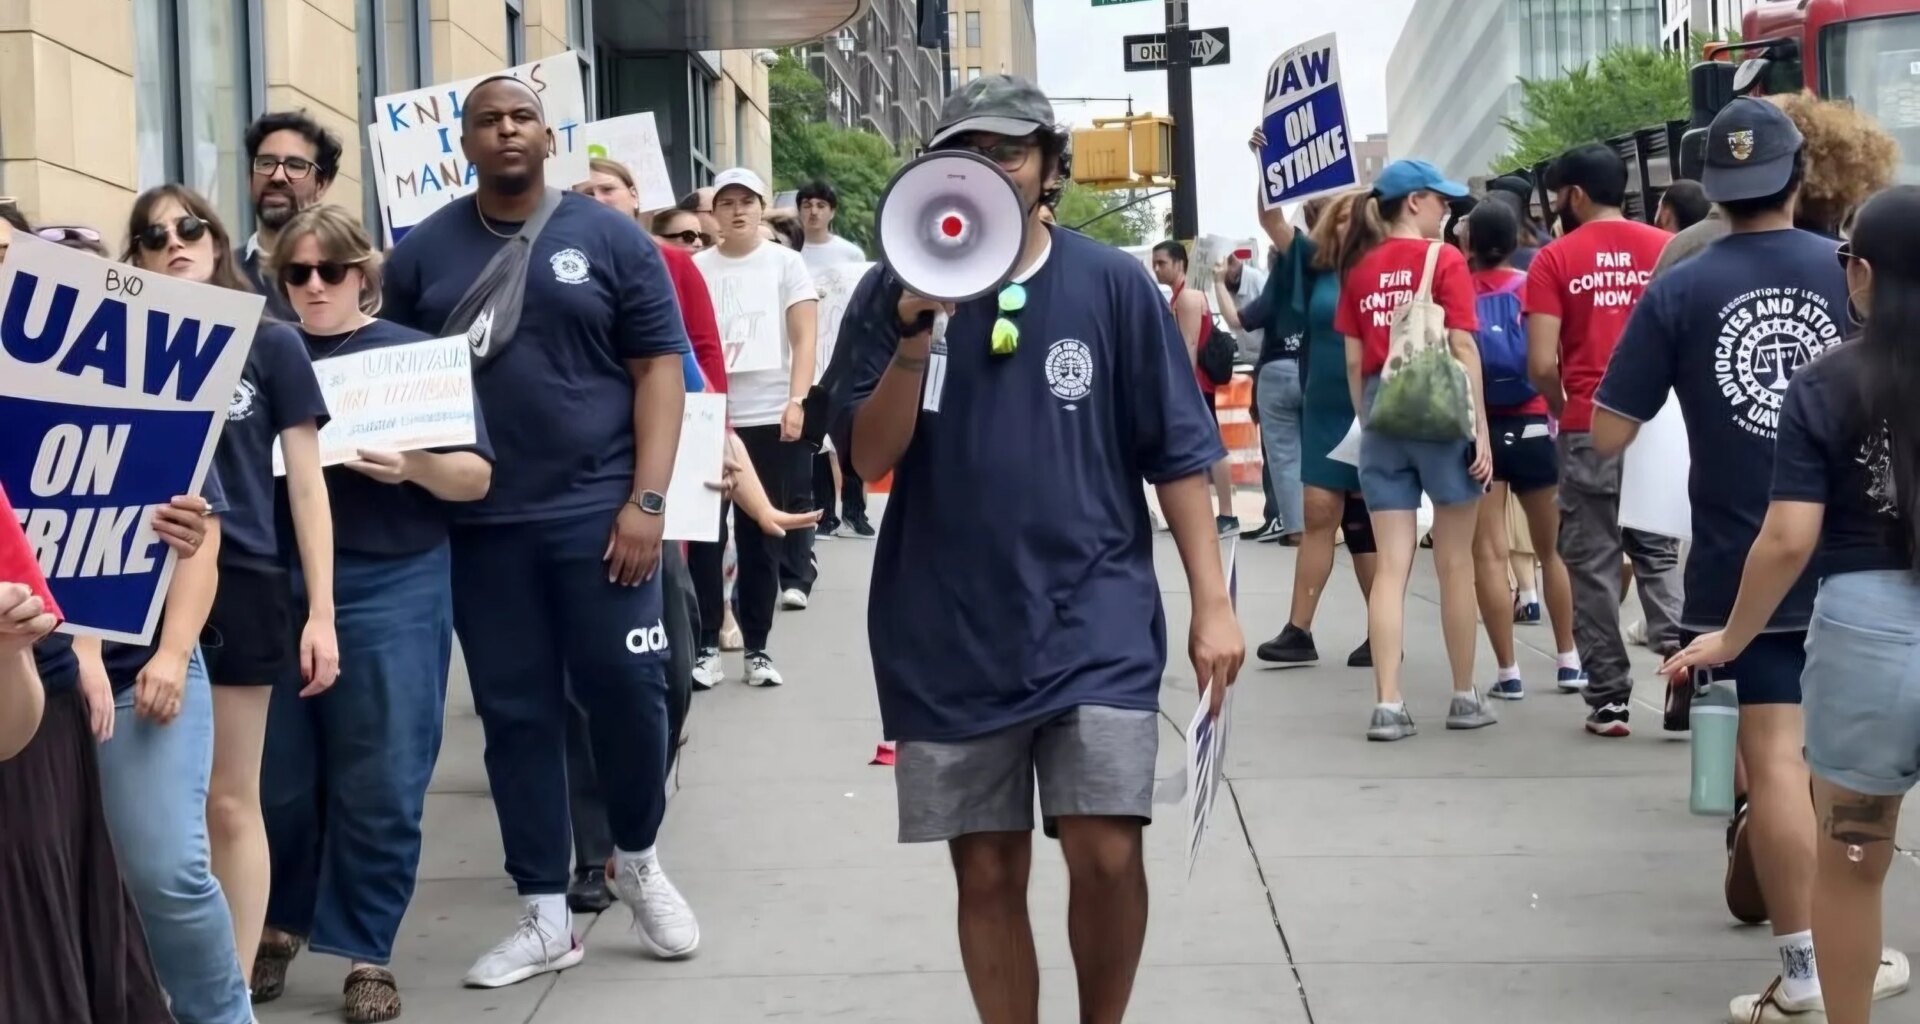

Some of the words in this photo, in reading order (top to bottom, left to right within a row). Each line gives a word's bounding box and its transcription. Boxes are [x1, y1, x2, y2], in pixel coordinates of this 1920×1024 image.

[1266, 48, 1331, 103] UAW
[1284, 101, 1317, 148] ON
[1266, 125, 1347, 197] STRIKE
[1596, 251, 1631, 268] FAIR
[1379, 270, 1412, 289] FAIR
[1568, 270, 1650, 294] CONTRAC
[1360, 289, 1414, 313] CONTRA
[1593, 290, 1637, 307] NOW.
[1784, 287, 1799, 296] OF
[1801, 289, 1829, 311] LEGAL
[0, 270, 236, 402] UAW
[1373, 310, 1393, 327] NO
[1714, 307, 1753, 407] ADVOCATES
[1756, 297, 1794, 317] AND
[1797, 302, 1842, 348] ATTOR
[30, 423, 131, 498] ON
[12, 503, 161, 579] RIKE
[626, 618, 668, 654] ad
